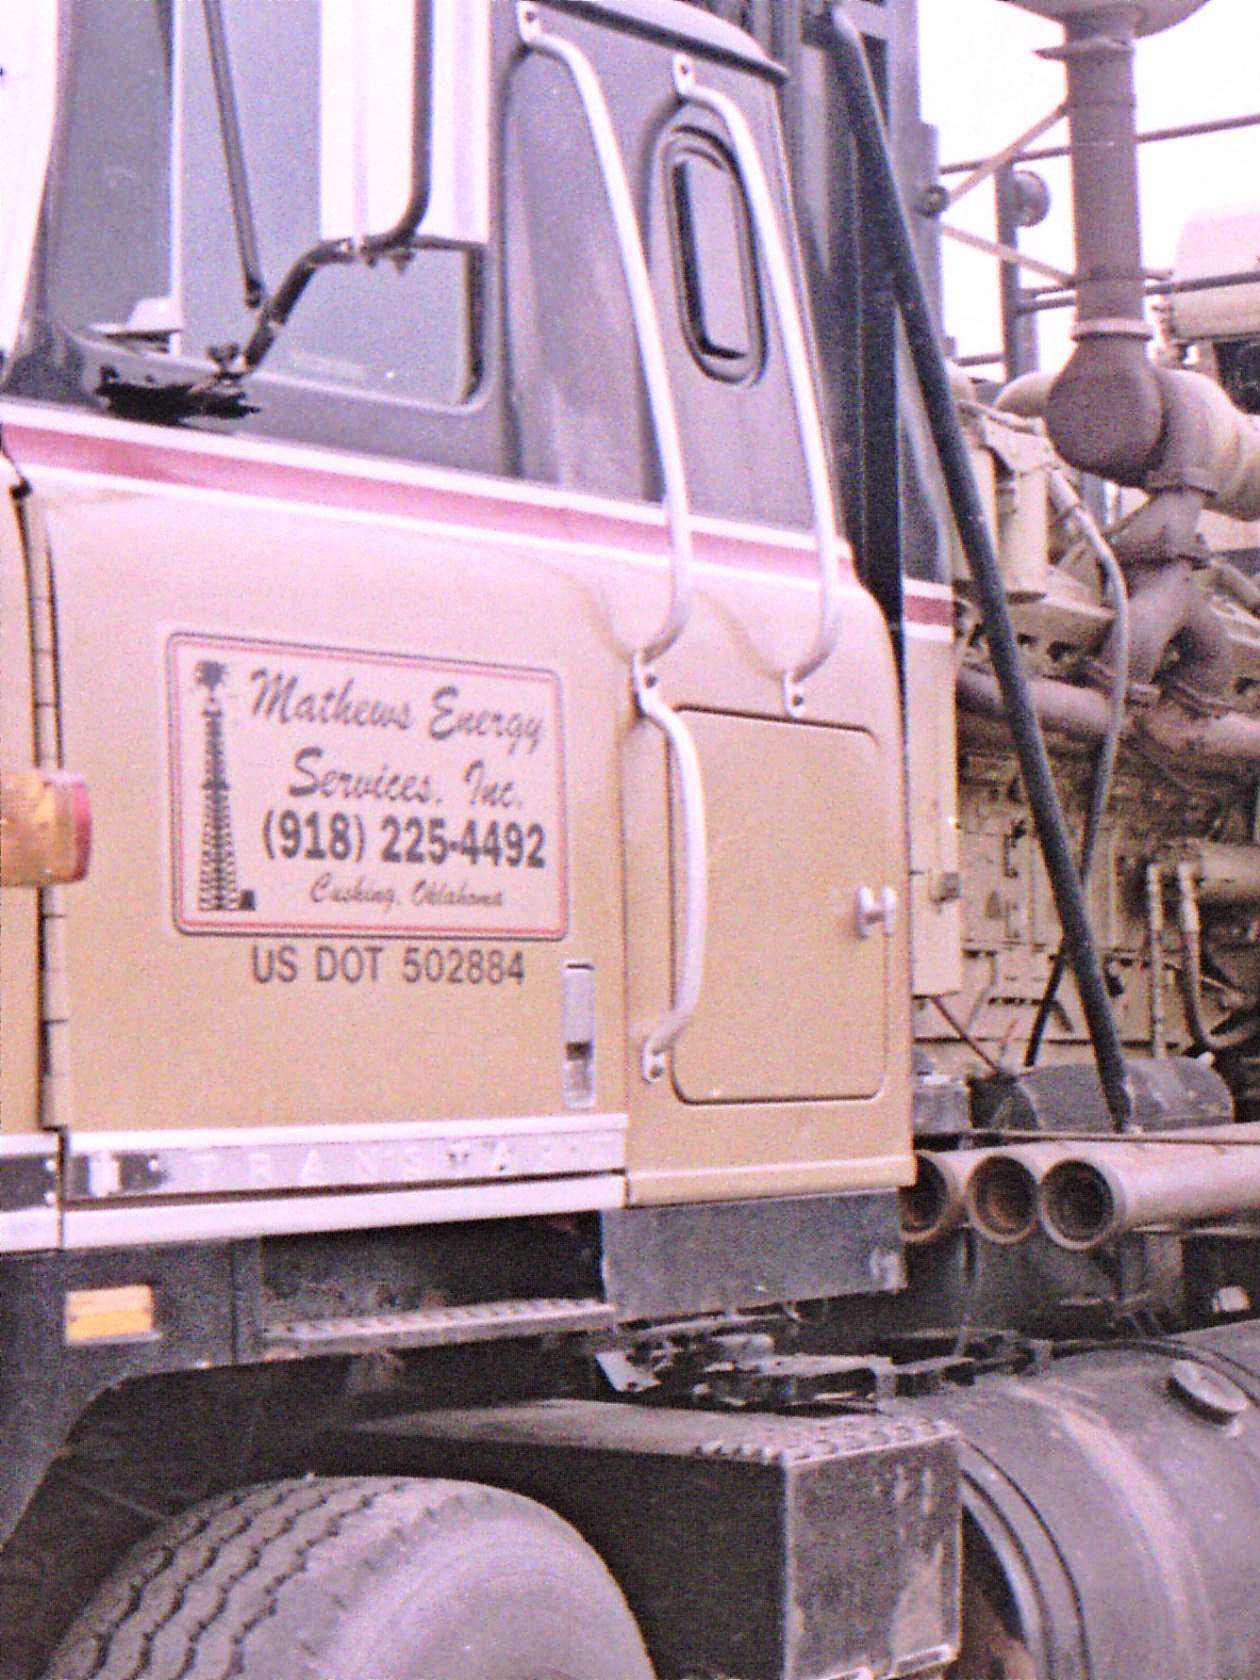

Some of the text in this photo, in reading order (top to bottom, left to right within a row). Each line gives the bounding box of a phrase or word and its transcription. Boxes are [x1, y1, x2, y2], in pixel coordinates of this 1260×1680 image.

[250, 667, 543, 756] Mathews Energy
[463, 759, 522, 809] Inc.
[263, 809, 547, 869] (918) 225-4492
[251, 944, 525, 986] US DOT 502884
